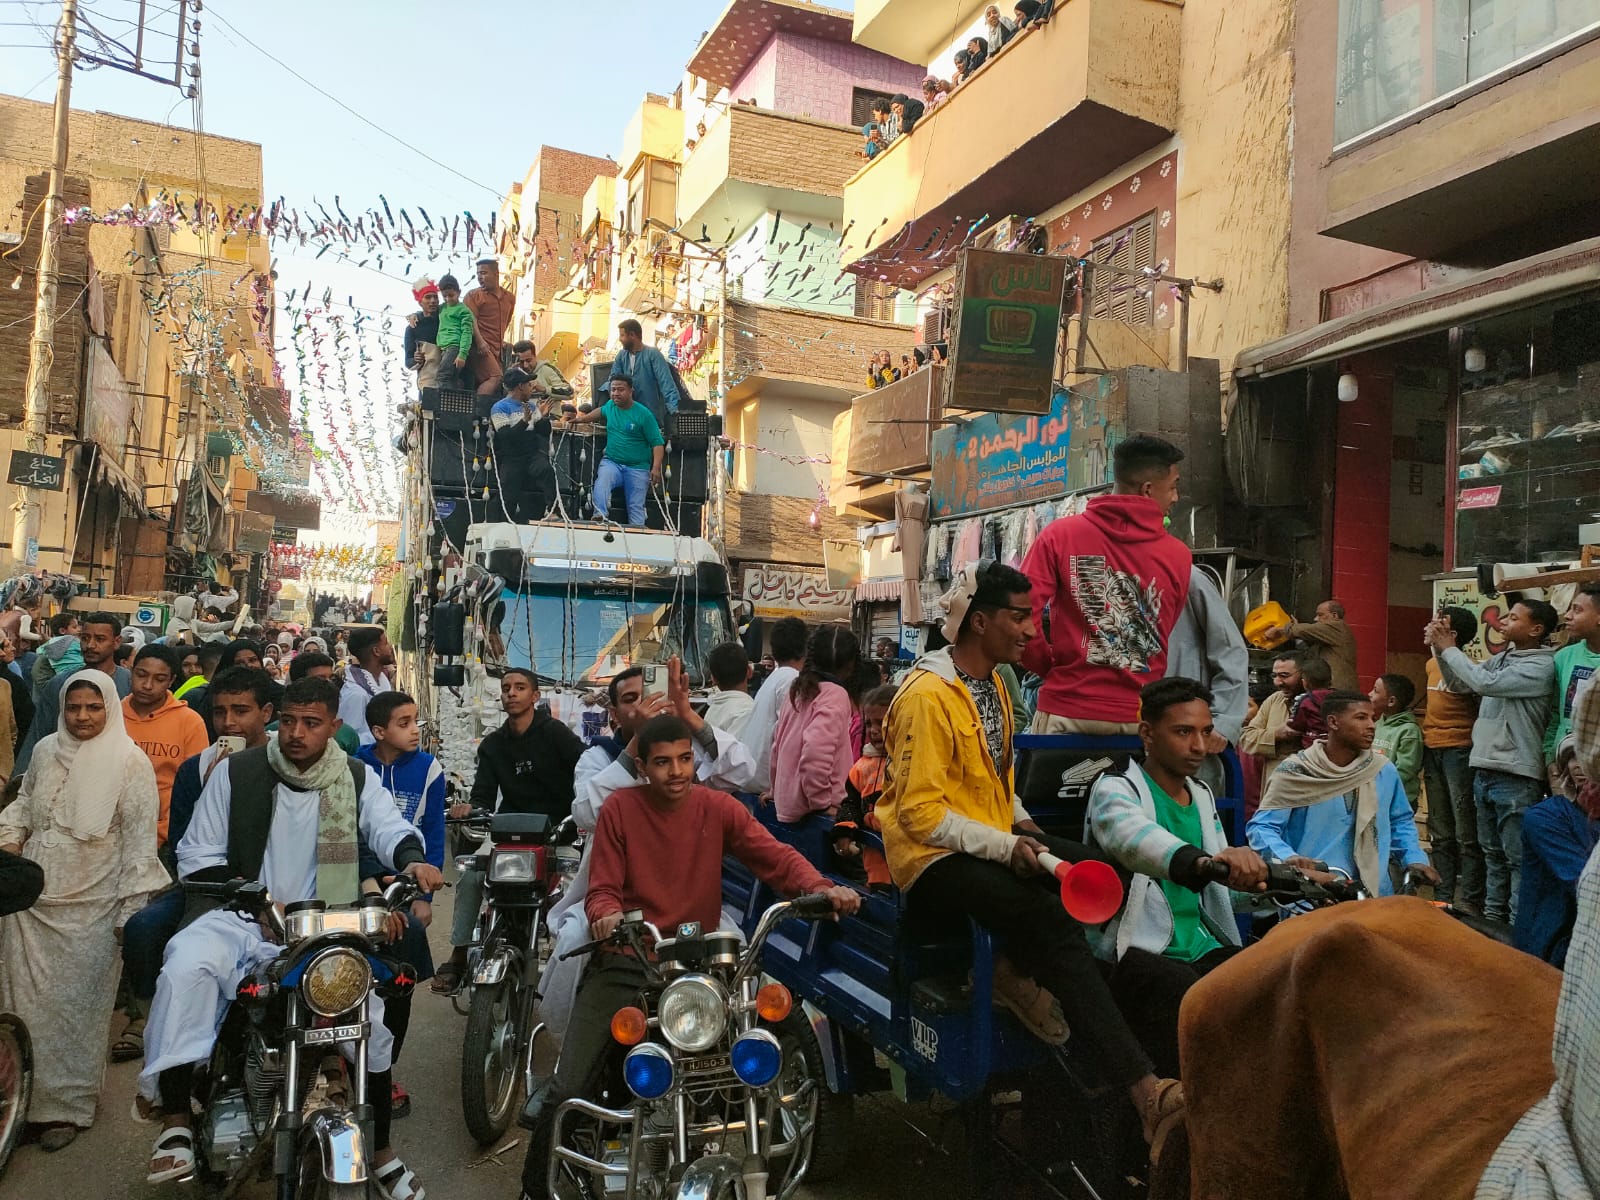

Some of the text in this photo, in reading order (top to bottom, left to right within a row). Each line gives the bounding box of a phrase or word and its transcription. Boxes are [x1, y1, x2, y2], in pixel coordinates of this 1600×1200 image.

[970, 404, 1069, 459] نور الرحمن 2
[1027, 446, 1066, 471] للملابس
[309, 1027, 358, 1041] DAYUN
